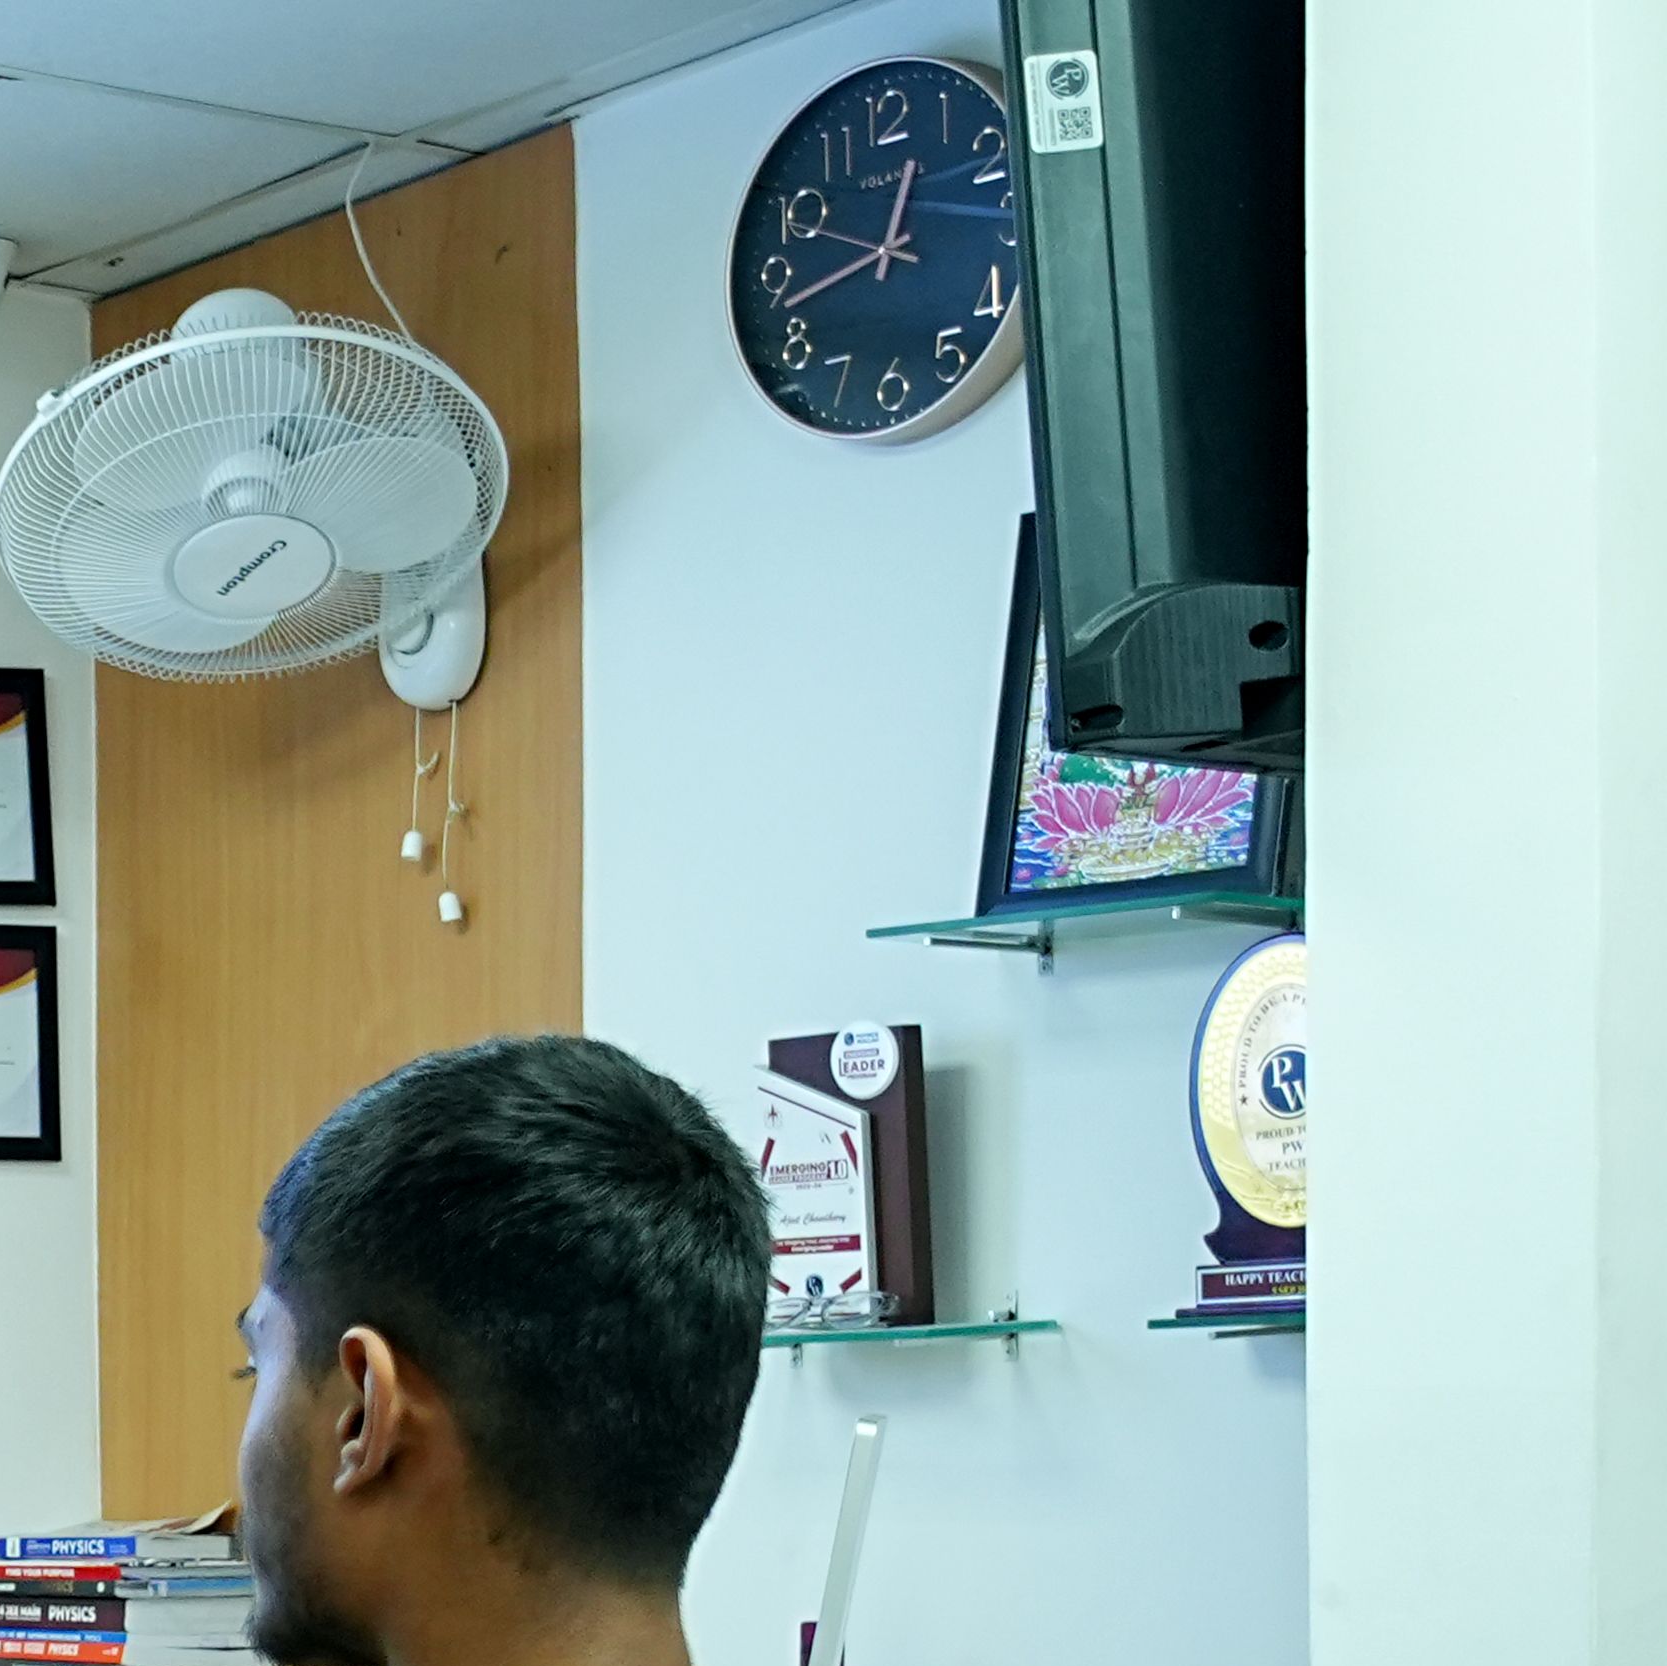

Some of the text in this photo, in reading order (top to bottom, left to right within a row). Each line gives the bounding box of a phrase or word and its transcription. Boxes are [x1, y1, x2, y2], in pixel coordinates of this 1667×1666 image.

[866, 90, 909, 148] 12
[939, 91, 948, 144] 1
[820, 126, 852, 182] 11
[972, 126, 1007, 185] 2
[777, 188, 827, 246] 10
[761, 255, 791, 309] 9
[972, 264, 1005, 319] 4
[782, 317, 811, 370] 8
[935, 325, 966, 384] 5
[824, 354, 852, 408] 7
[877, 356, 911, 412] 6
[216, 540, 287, 596] Crompton
[1225, 1273, 1265, 1286] HAPPY
[52, 1539, 104, 1556] PHYSICS
[48, 1604, 97, 1623] PHYSICS
